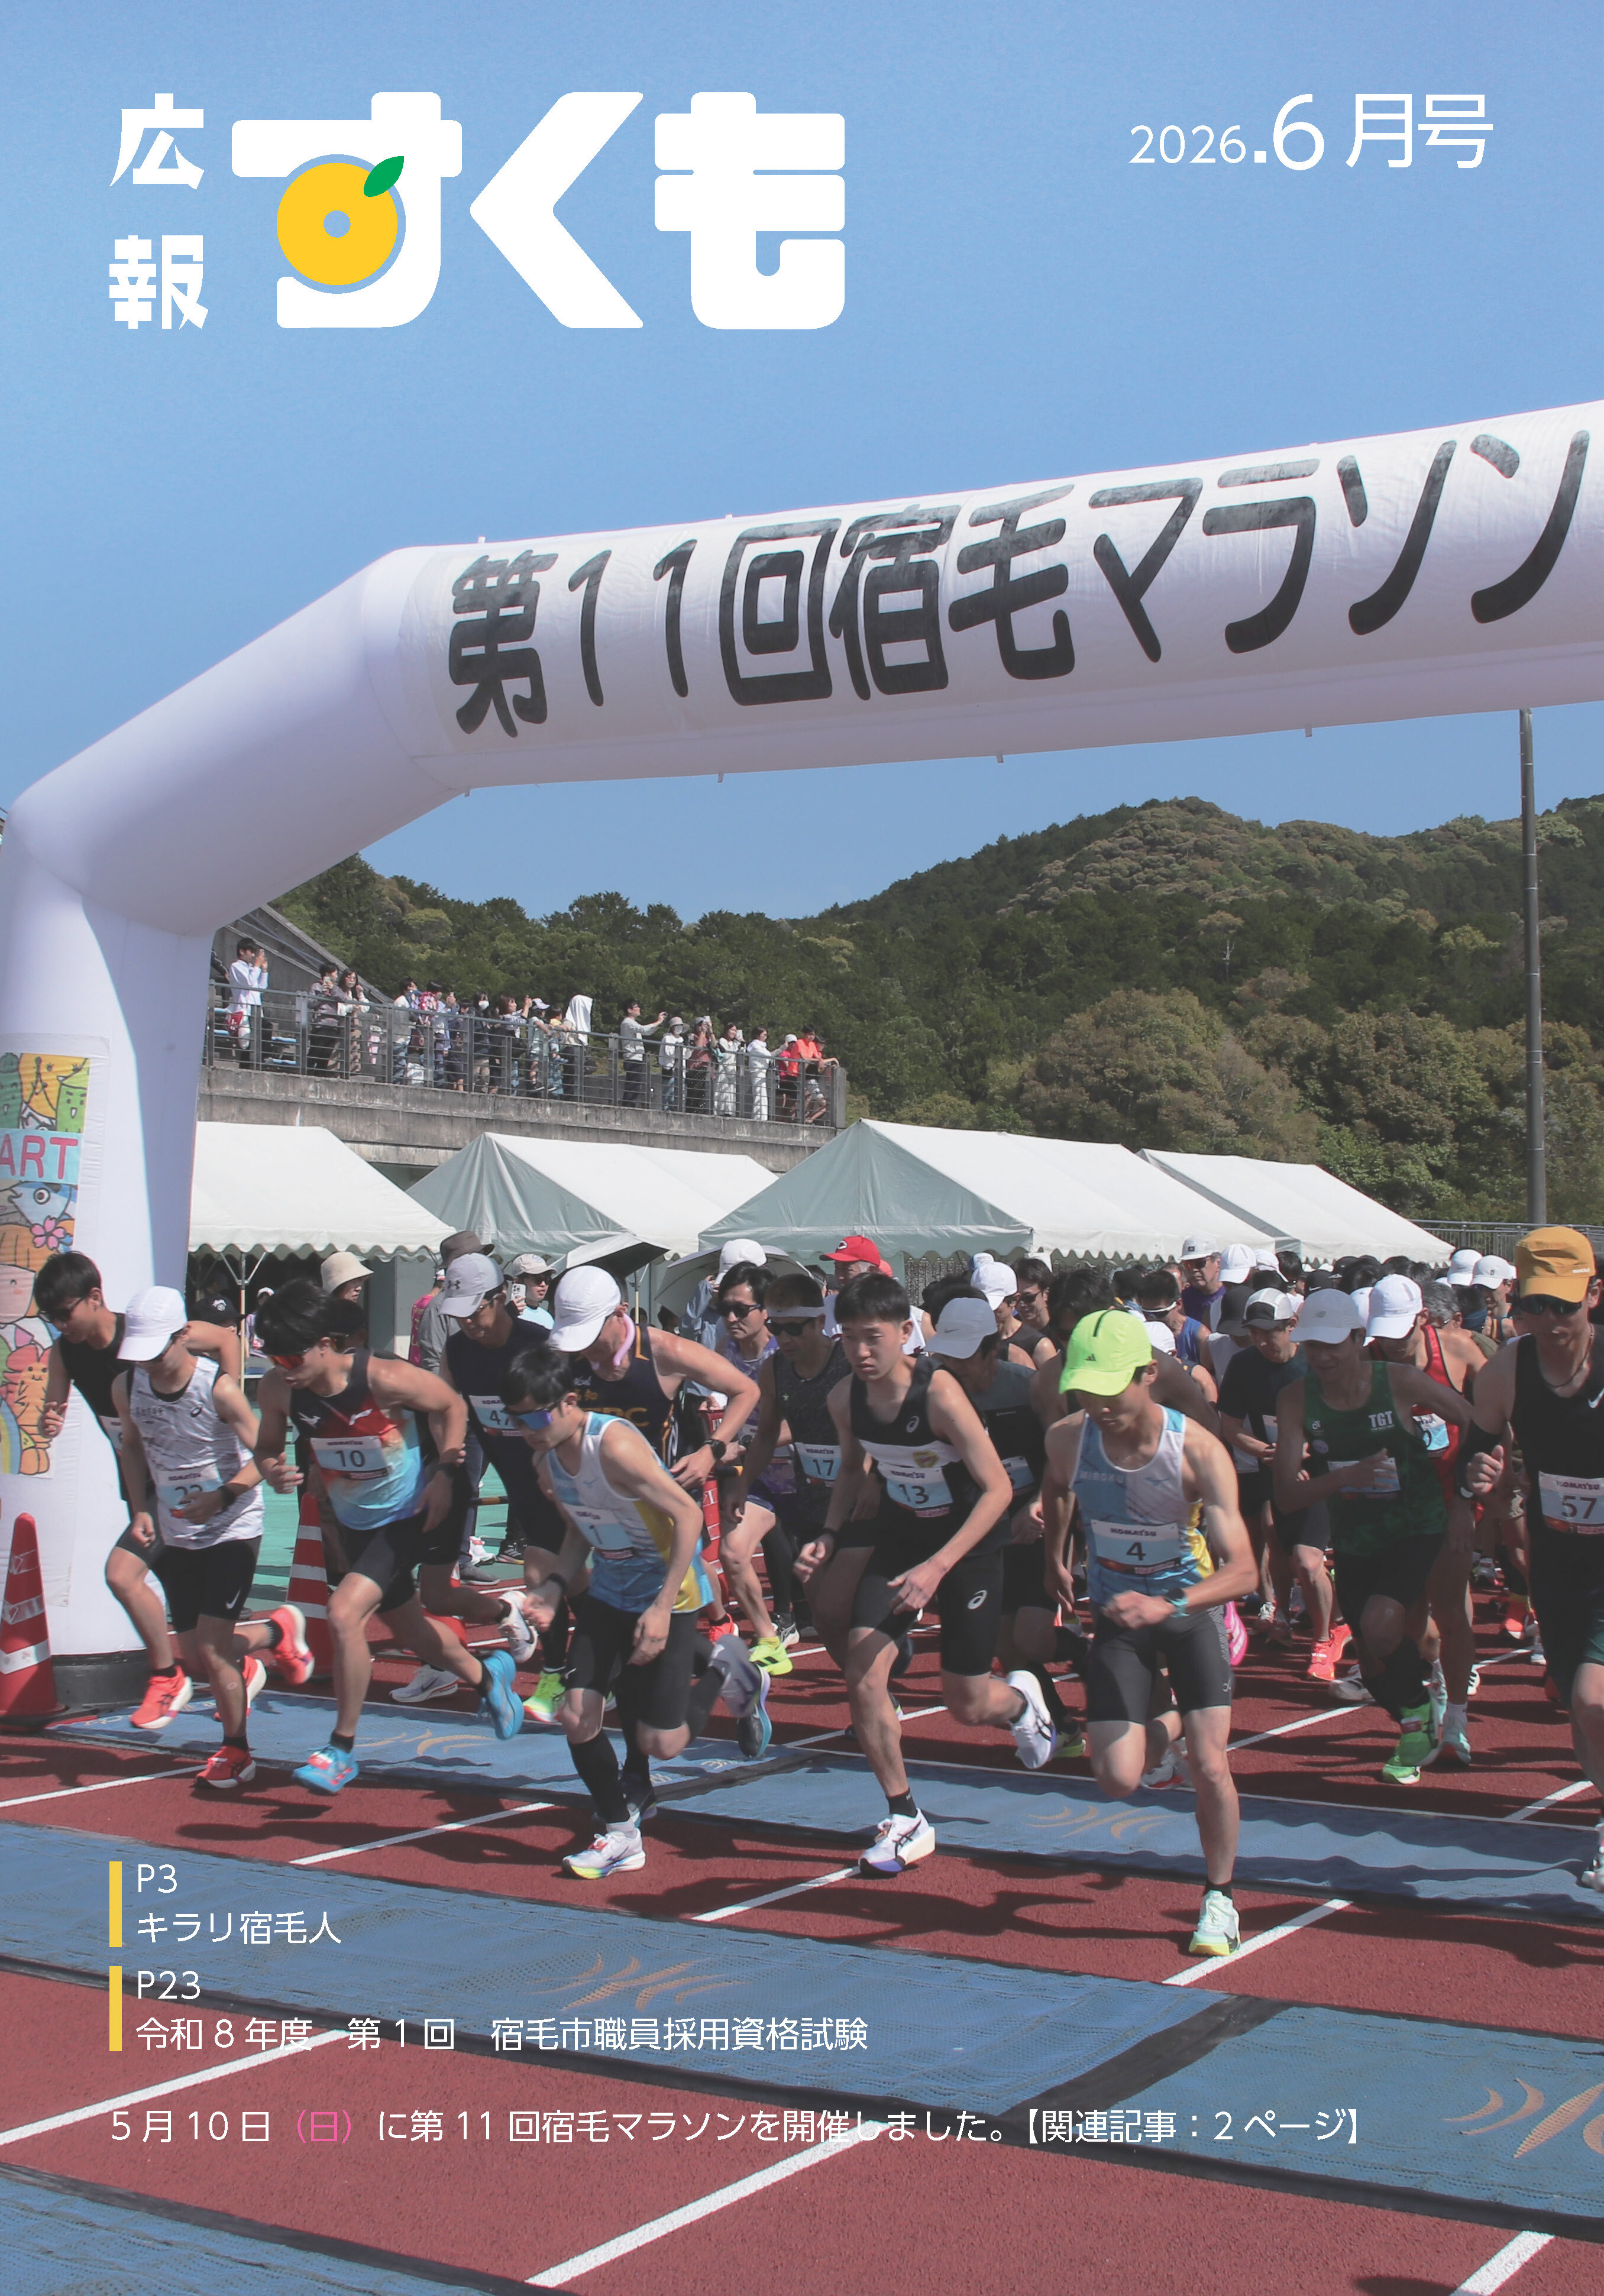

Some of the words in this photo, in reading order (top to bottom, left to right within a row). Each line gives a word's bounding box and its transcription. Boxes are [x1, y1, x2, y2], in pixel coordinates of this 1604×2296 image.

[449, 430, 1590, 737] 第11回宿毛マラソン
[0, 1134, 79, 1180] ART
[1368, 1410, 1393, 1428] TGT
[335, 1450, 366, 1468] 10
[812, 1459, 835, 1476] 17
[898, 1484, 929, 1504] 13
[1561, 1495, 1597, 1519] 57
[1110, 1527, 1157, 1537] KOMATSU
[1126, 1542, 1147, 1562] 4
